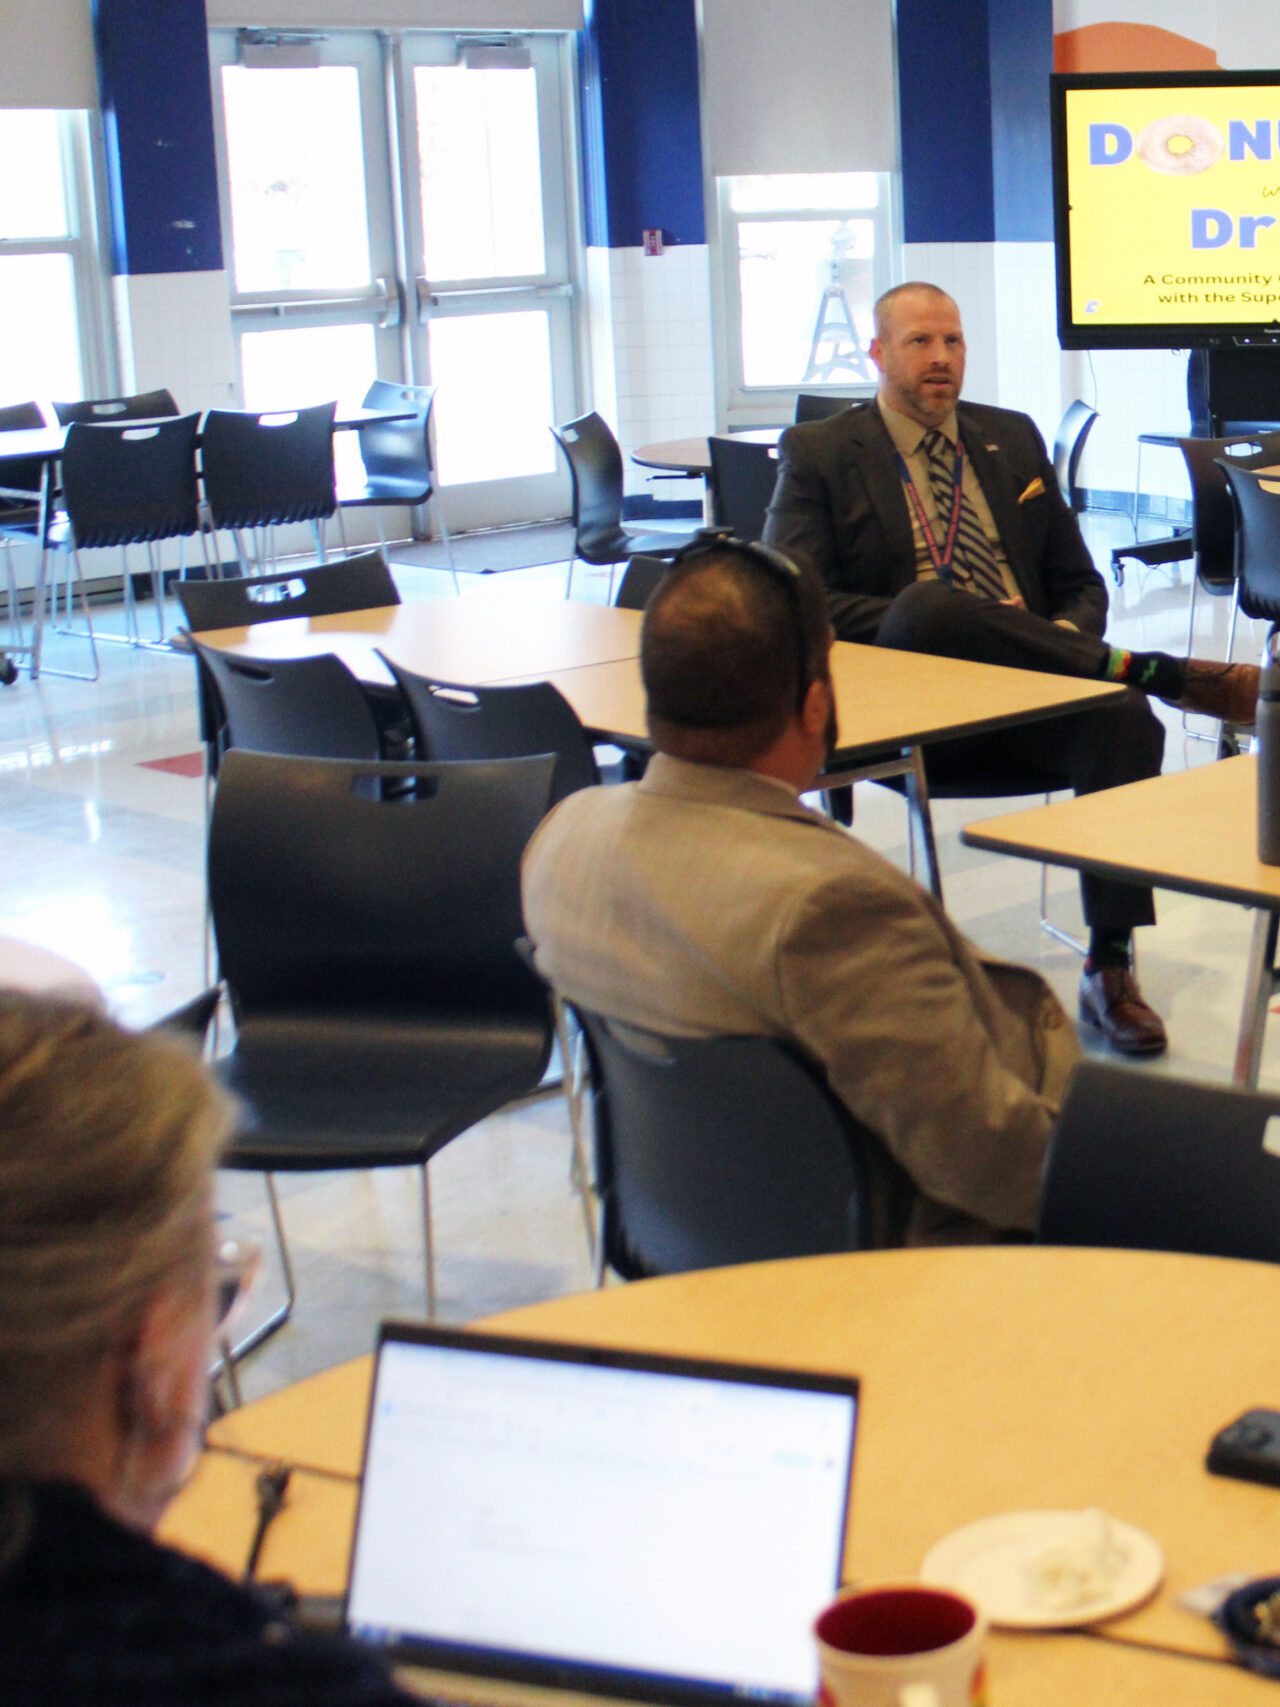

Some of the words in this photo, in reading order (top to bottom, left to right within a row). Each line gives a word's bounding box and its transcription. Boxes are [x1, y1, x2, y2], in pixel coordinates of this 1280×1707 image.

[1143, 274, 1156, 285] A
[1161, 272, 1273, 286] Community
[1158, 291, 1199, 303] with
[1204, 291, 1236, 303] the
